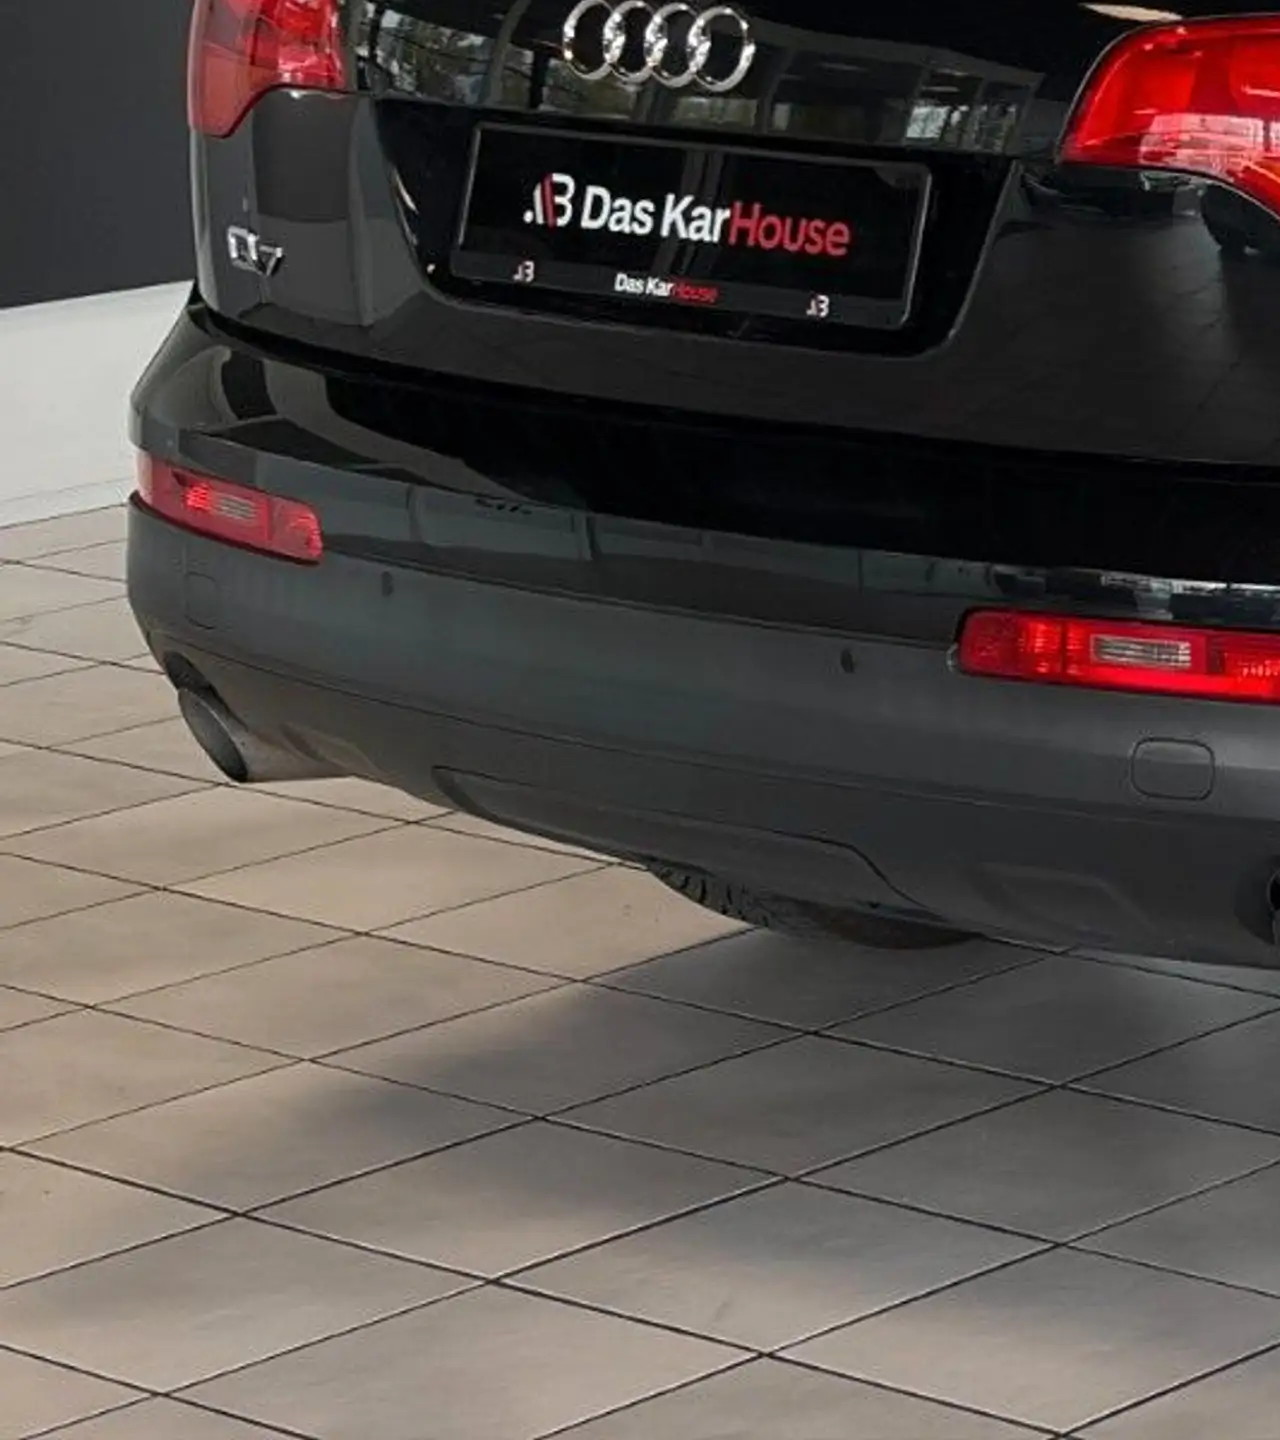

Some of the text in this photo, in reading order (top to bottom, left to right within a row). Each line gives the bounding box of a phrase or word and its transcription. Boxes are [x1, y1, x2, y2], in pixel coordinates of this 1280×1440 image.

[580, 185, 655, 236] Das
[659, 193, 850, 257] KarHouse
[614, 272, 645, 294] Das
